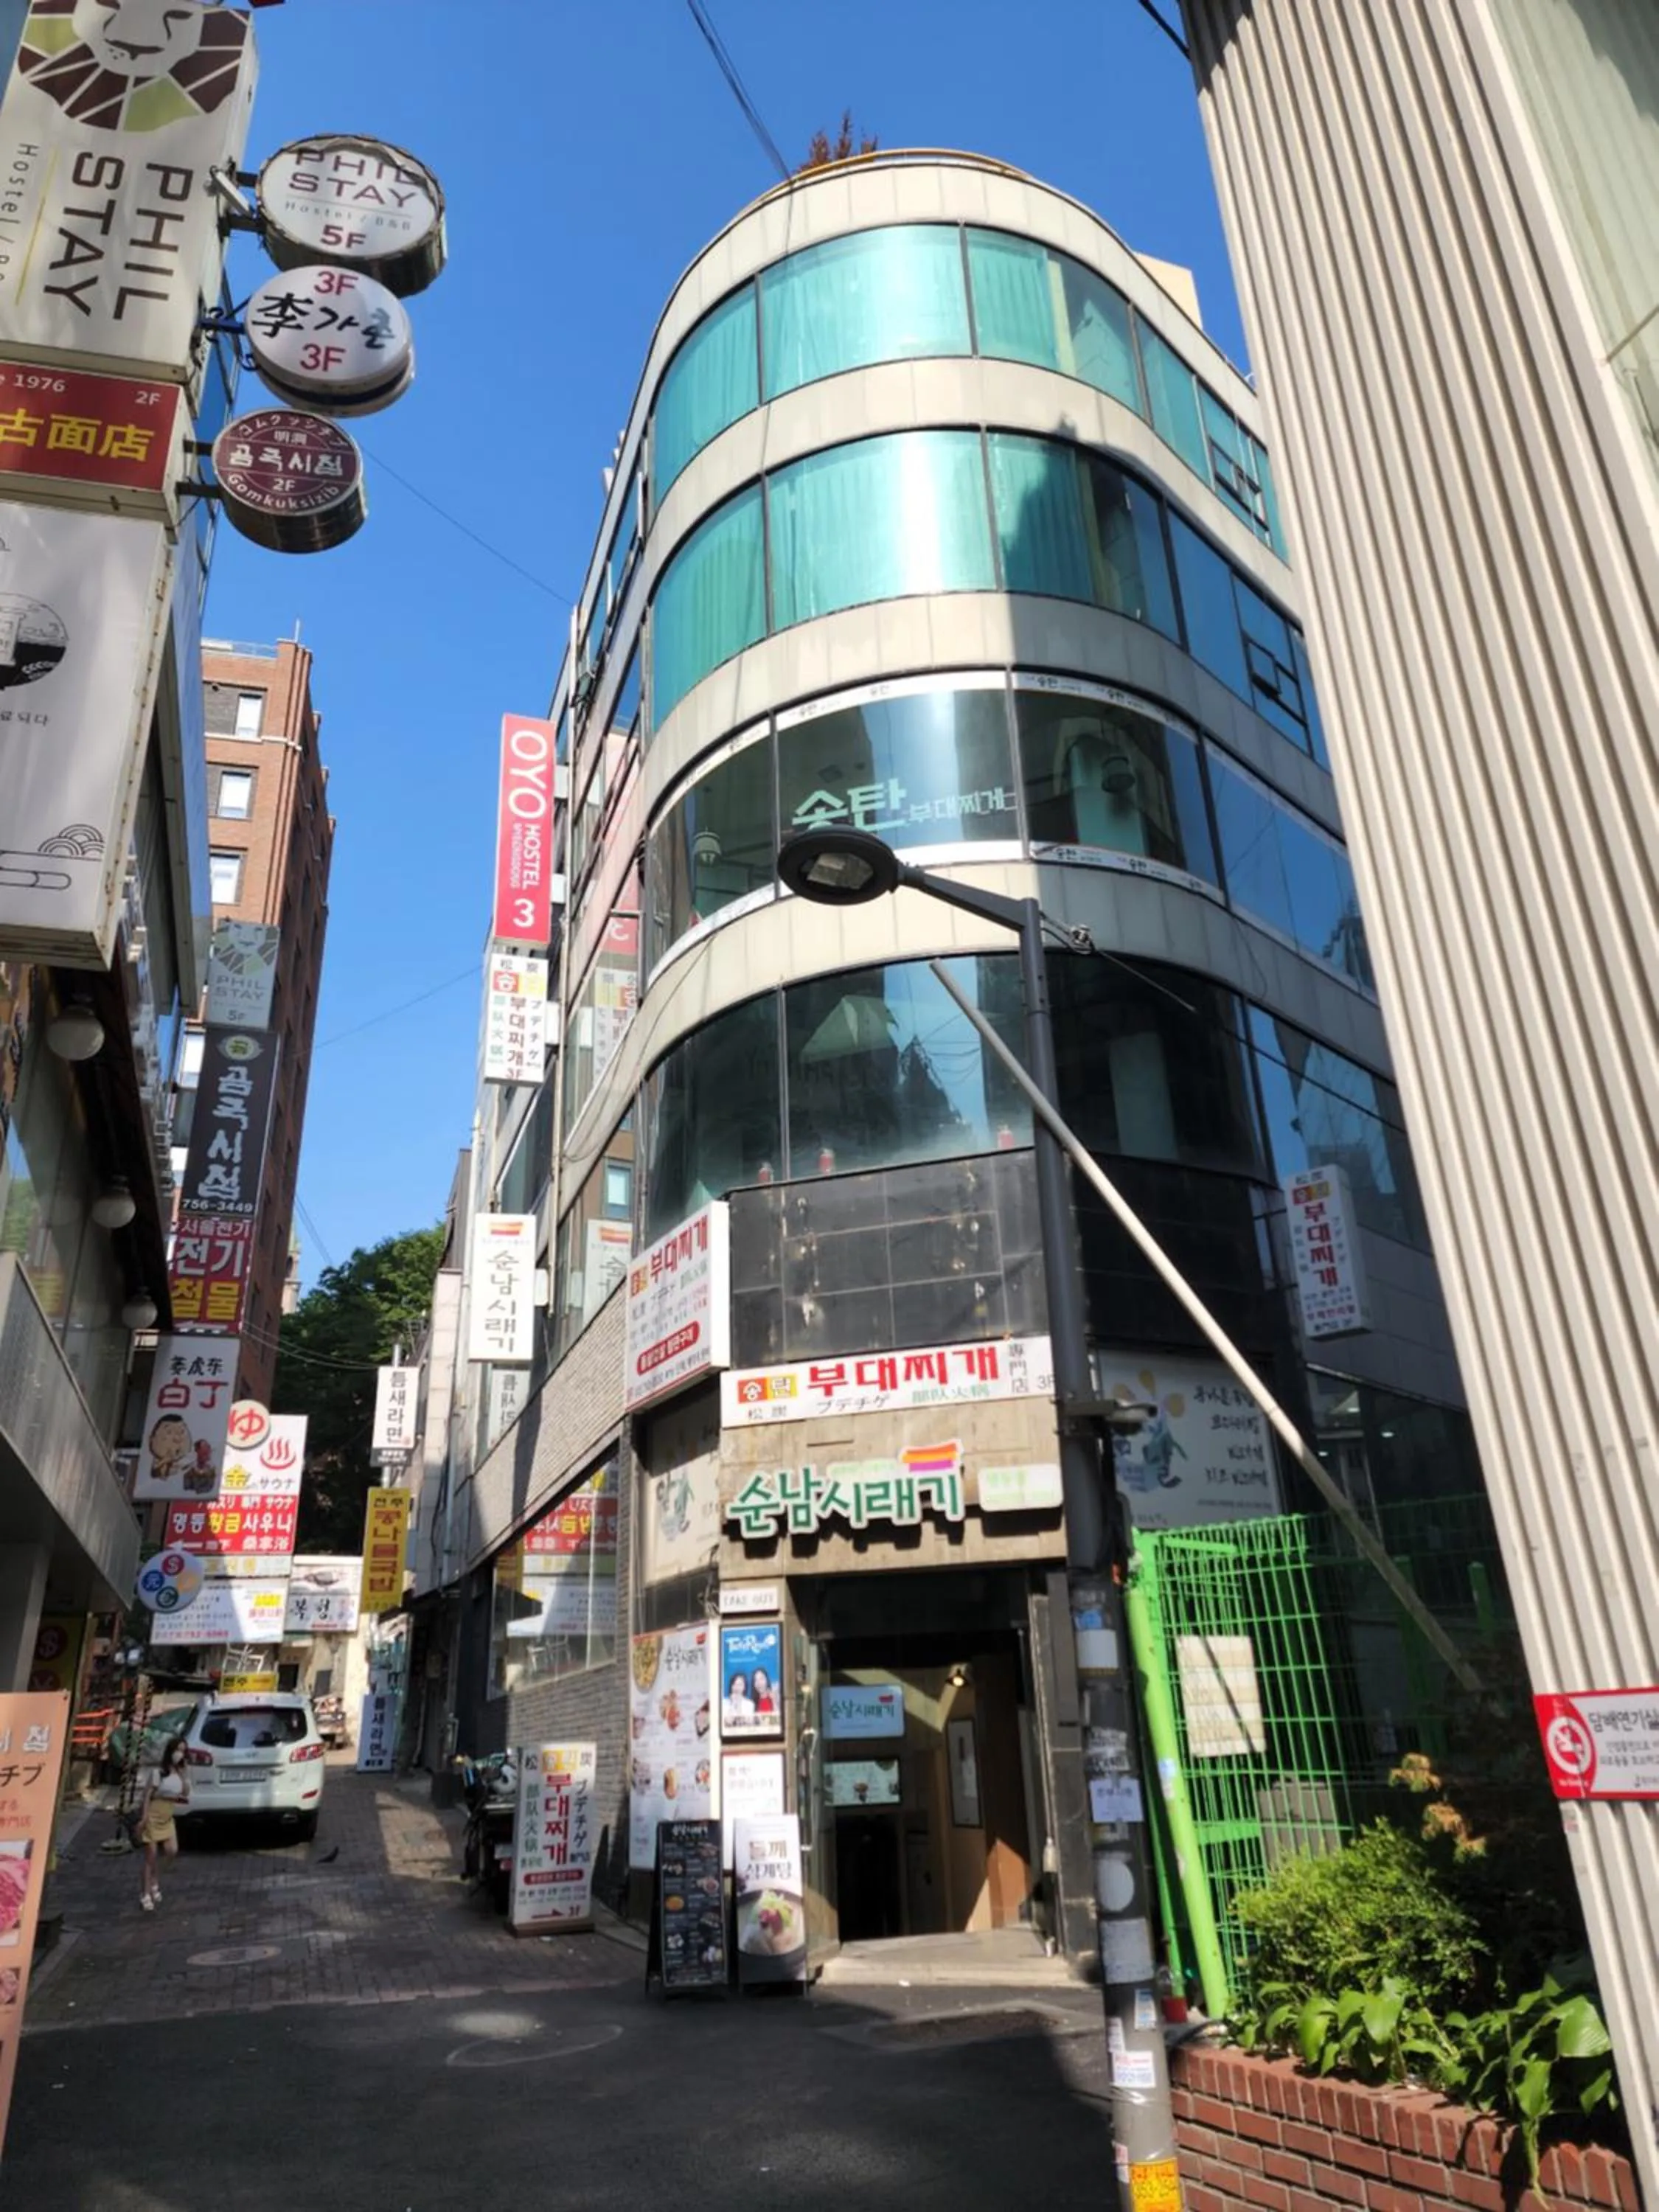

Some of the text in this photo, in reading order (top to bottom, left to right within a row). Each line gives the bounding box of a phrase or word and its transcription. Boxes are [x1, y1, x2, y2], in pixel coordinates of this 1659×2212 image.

[296, 148, 415, 184] PHIL
[289, 172, 417, 208] STAY
[44, 151, 125, 317] STAY
[113, 161, 193, 321] PHIL
[320, 224, 366, 248] 5F
[313, 271, 359, 296] 3F
[299, 343, 347, 372] 3F
[13, 374, 66, 393] 1976
[134, 390, 161, 406] 2F
[227, 473, 340, 509] Gomkuksizib
[272, 477, 297, 492] 2F
[508, 730, 548, 819] OYO
[522, 821, 541, 891] HOSTEL
[512, 897, 535, 928] 3
[181, 1197, 254, 1214] 756-3449
[175, 1237, 245, 1278] 전기
[650, 1214, 709, 1284] 부대찌개
[170, 1278, 240, 1321] 철물
[484, 1250, 519, 1353] 순남시래기
[807, 1346, 1000, 1397] 부대찌개
[157, 1377, 229, 1409] 白丁
[386, 1371, 408, 1444] 틈새라면
[228, 1408, 266, 1441] ゆ
[728, 1466, 960, 1534] 순남시래기
[543, 1773, 571, 1866] 부대찌개
